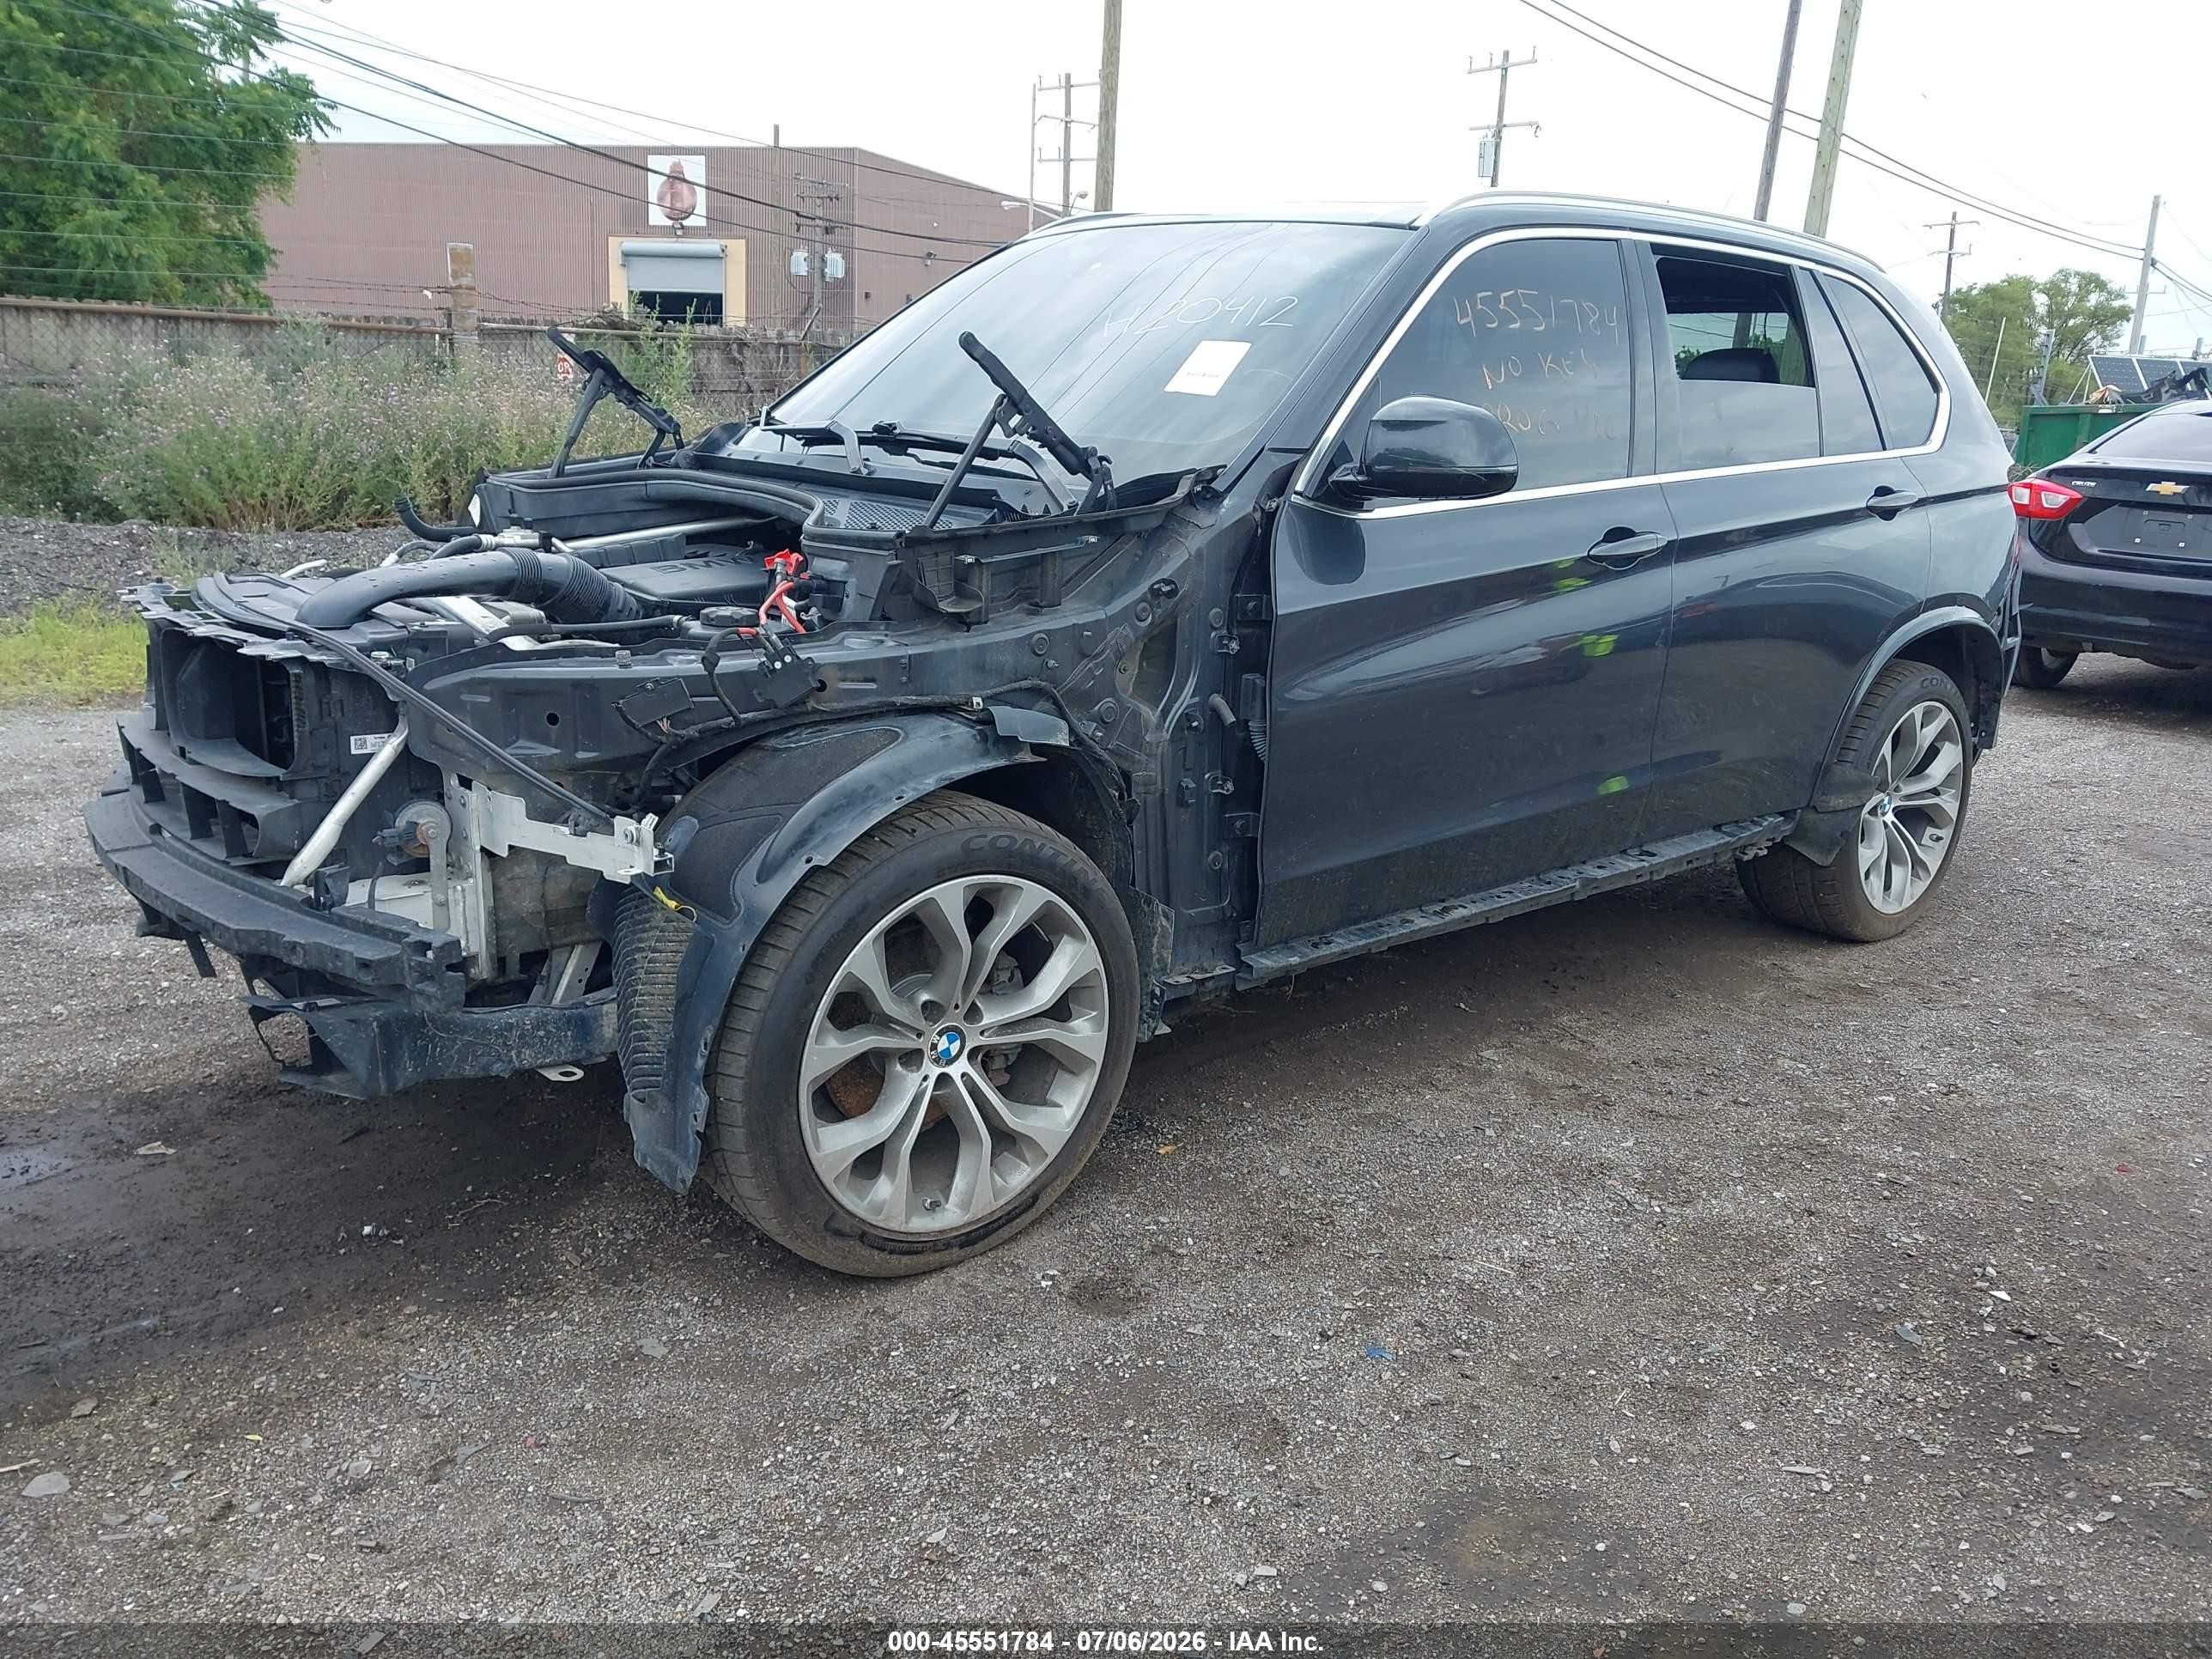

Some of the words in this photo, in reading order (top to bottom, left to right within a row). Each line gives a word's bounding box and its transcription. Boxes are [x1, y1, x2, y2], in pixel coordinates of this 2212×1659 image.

[1453, 289, 1620, 347] 45551784
[1482, 355, 1522, 390] NO
[649, 556, 753, 574] BMW
